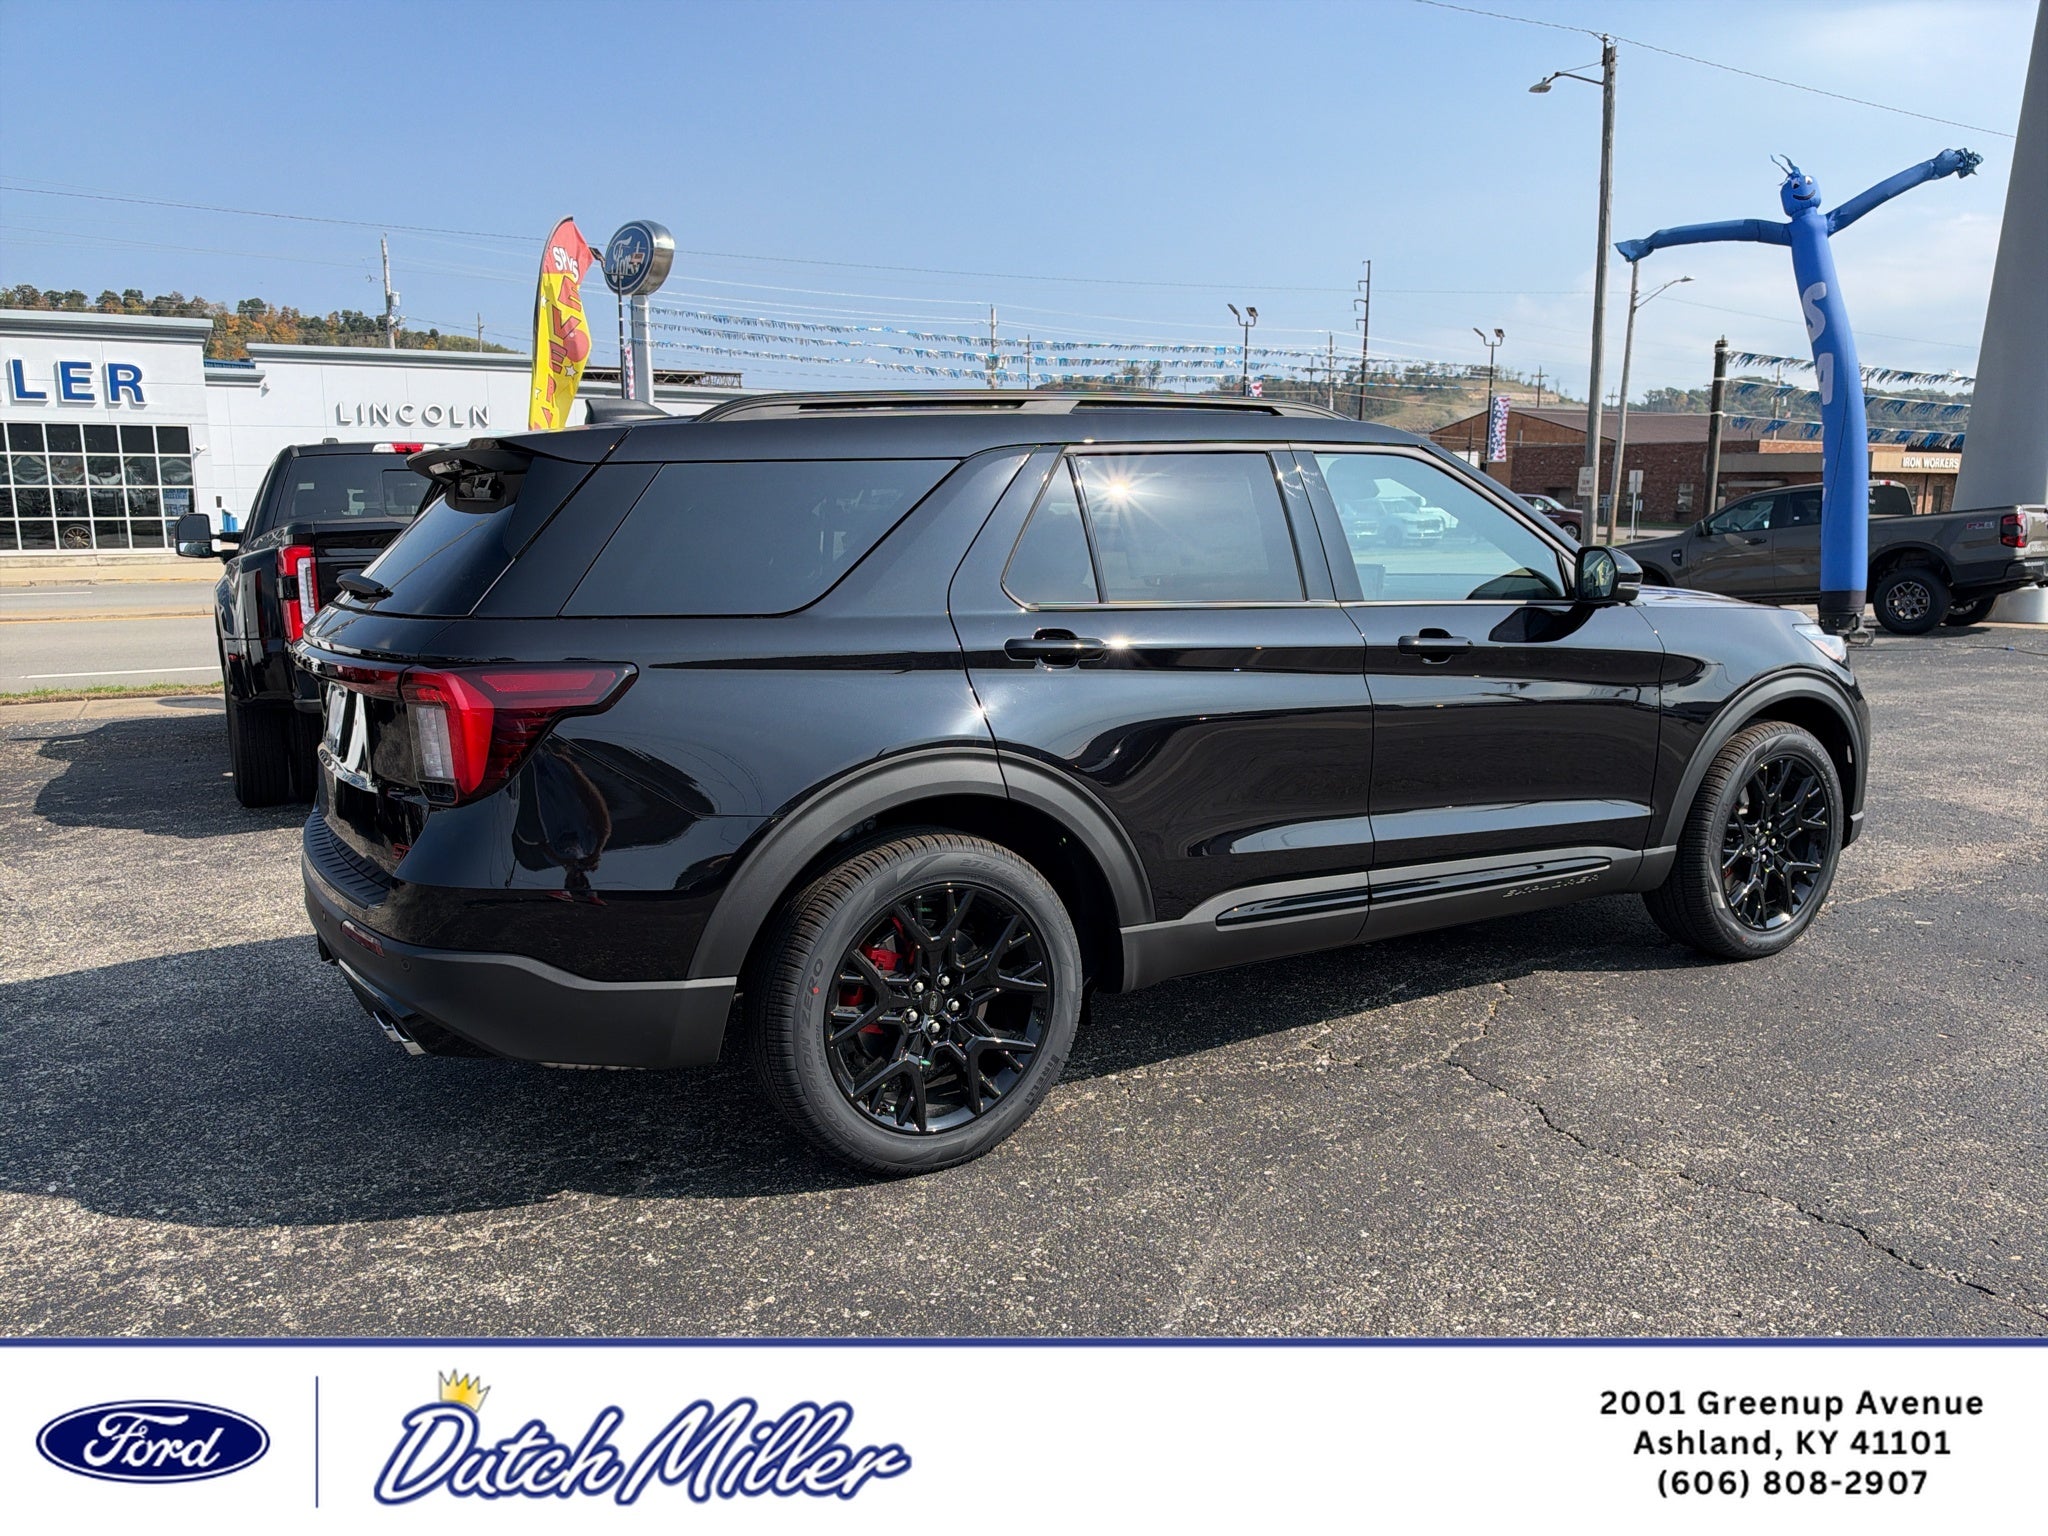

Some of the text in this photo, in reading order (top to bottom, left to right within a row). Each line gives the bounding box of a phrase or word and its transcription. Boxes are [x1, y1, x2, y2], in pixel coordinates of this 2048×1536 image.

[336, 402, 490, 428] LINCOLN
[1902, 456, 1960, 469] IRON WORKERS
[802, 957, 824, 1029] ZERO
